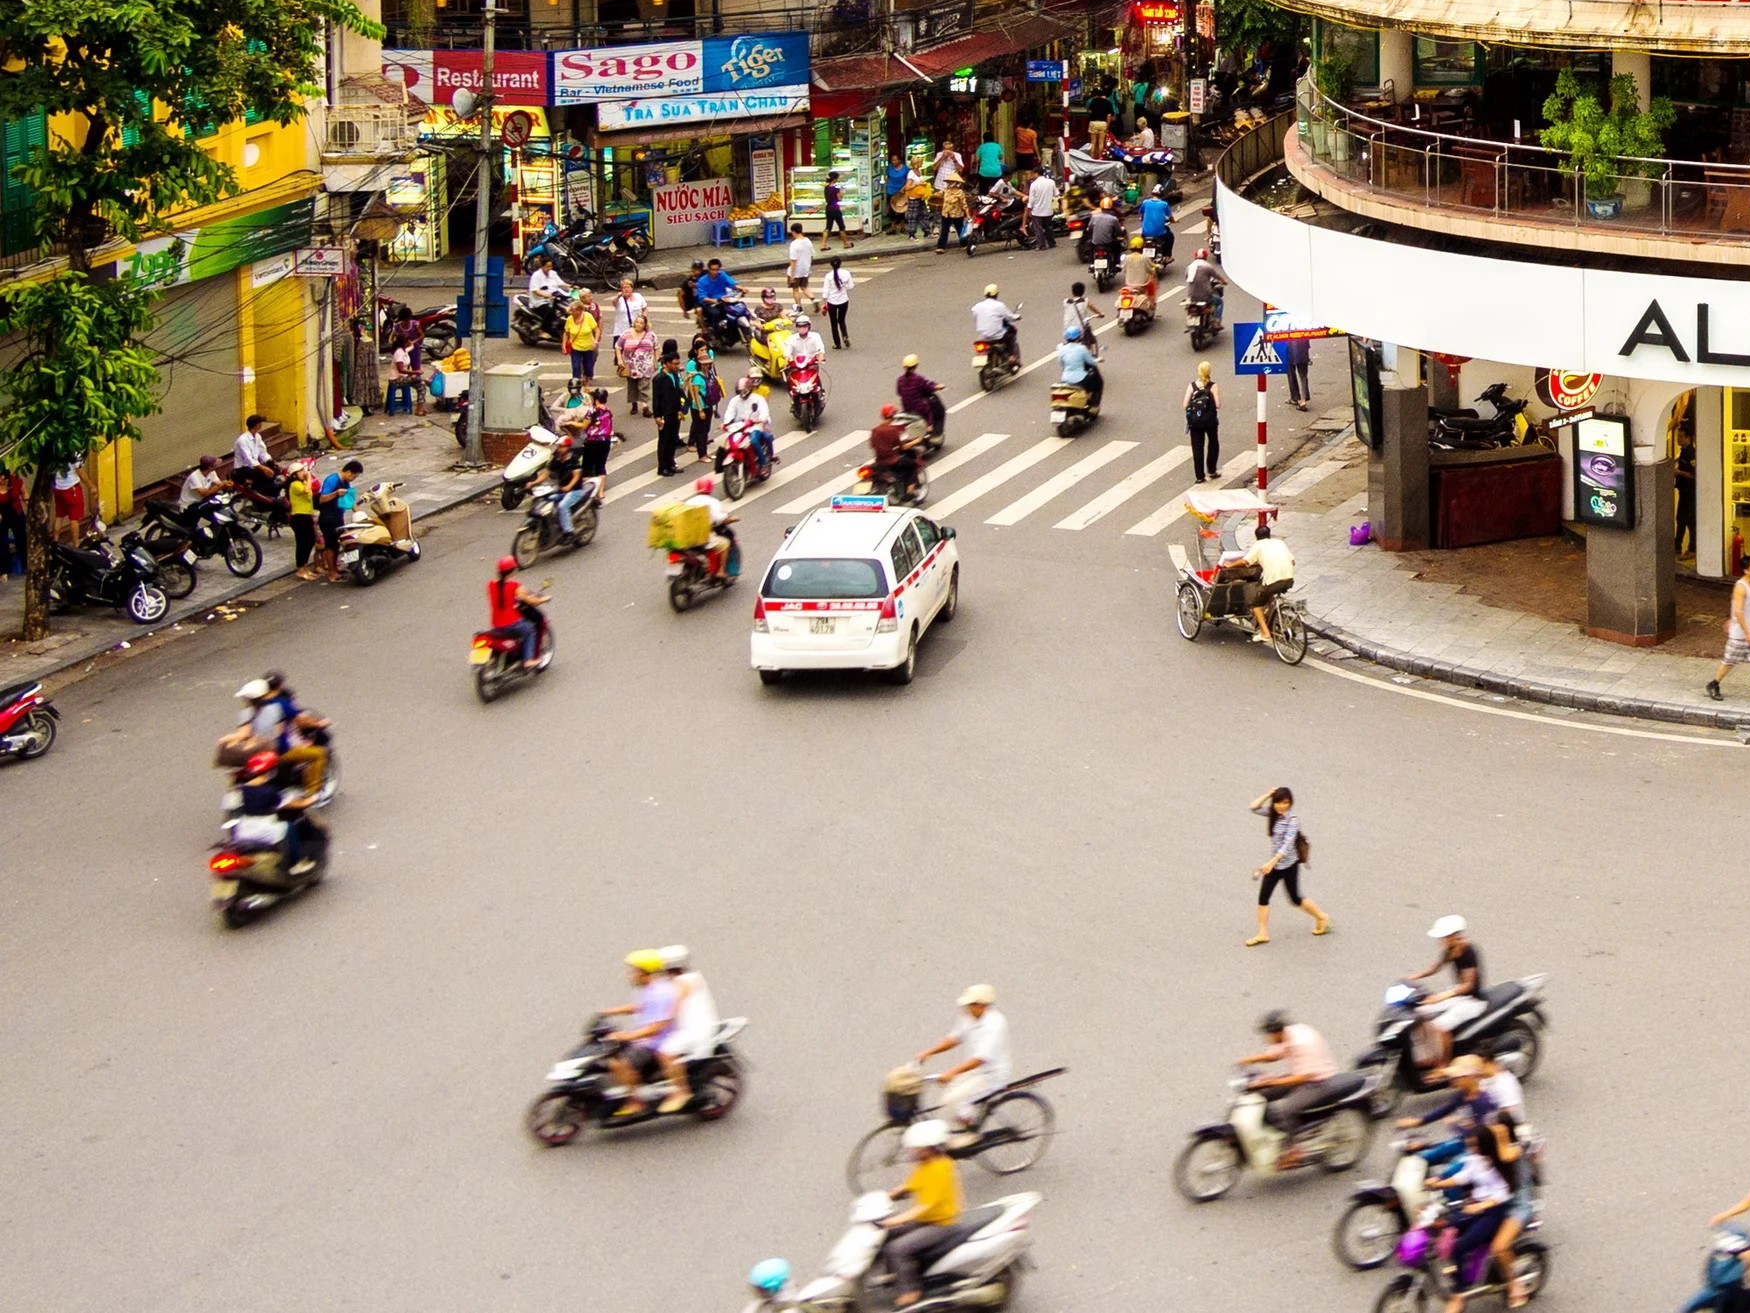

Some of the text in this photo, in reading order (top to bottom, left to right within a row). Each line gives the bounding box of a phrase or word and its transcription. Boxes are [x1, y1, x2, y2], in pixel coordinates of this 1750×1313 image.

[560, 50, 697, 82] Sago
[722, 44, 787, 87] Tiger
[560, 86, 581, 97] Bar
[594, 80, 665, 96] Vietnamese
[668, 76, 700, 88] Food
[655, 184, 700, 213] NƯỚC
[702, 179, 733, 208] MÍA
[666, 208, 726, 225] SIÊU SẠCH
[1557, 381, 1597, 406] COFFEE
